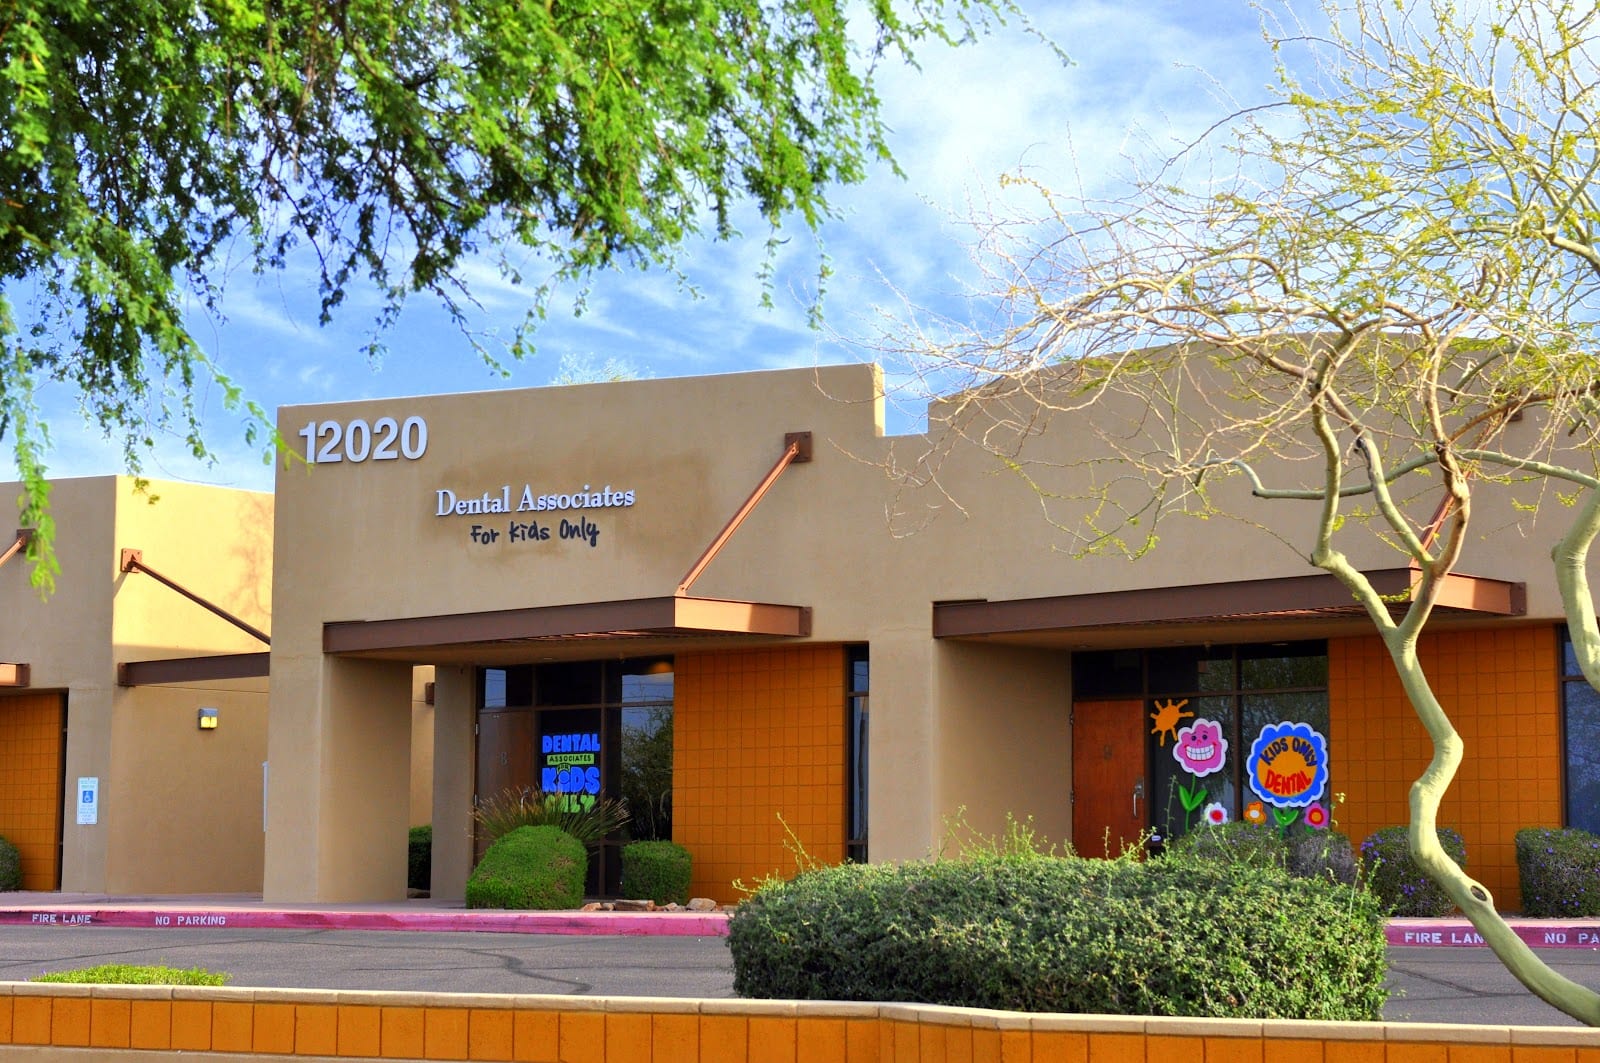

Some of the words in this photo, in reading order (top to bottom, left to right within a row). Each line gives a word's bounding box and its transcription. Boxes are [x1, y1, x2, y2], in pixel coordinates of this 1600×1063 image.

[299, 415, 428, 464] 12020
[435, 485, 511, 516] Dental
[516, 484, 636, 512] Associates
[470, 525, 500, 545] For
[559, 516, 600, 547] Only
[542, 734, 600, 753] DENTAL
[1260, 738, 1288, 766] KIDS
[1292, 737, 1317, 766] ONLY
[1264, 769, 1311, 794] DENTAL
[32, 913, 57, 923] FIRE
[62, 914, 92, 924] LANE
[155, 916, 170, 926] NO
[177, 915, 226, 926] PARKING
[1404, 932, 1442, 944] FIRE
[1451, 932, 1485, 944] LAN
[1544, 932, 1567, 944] NO
